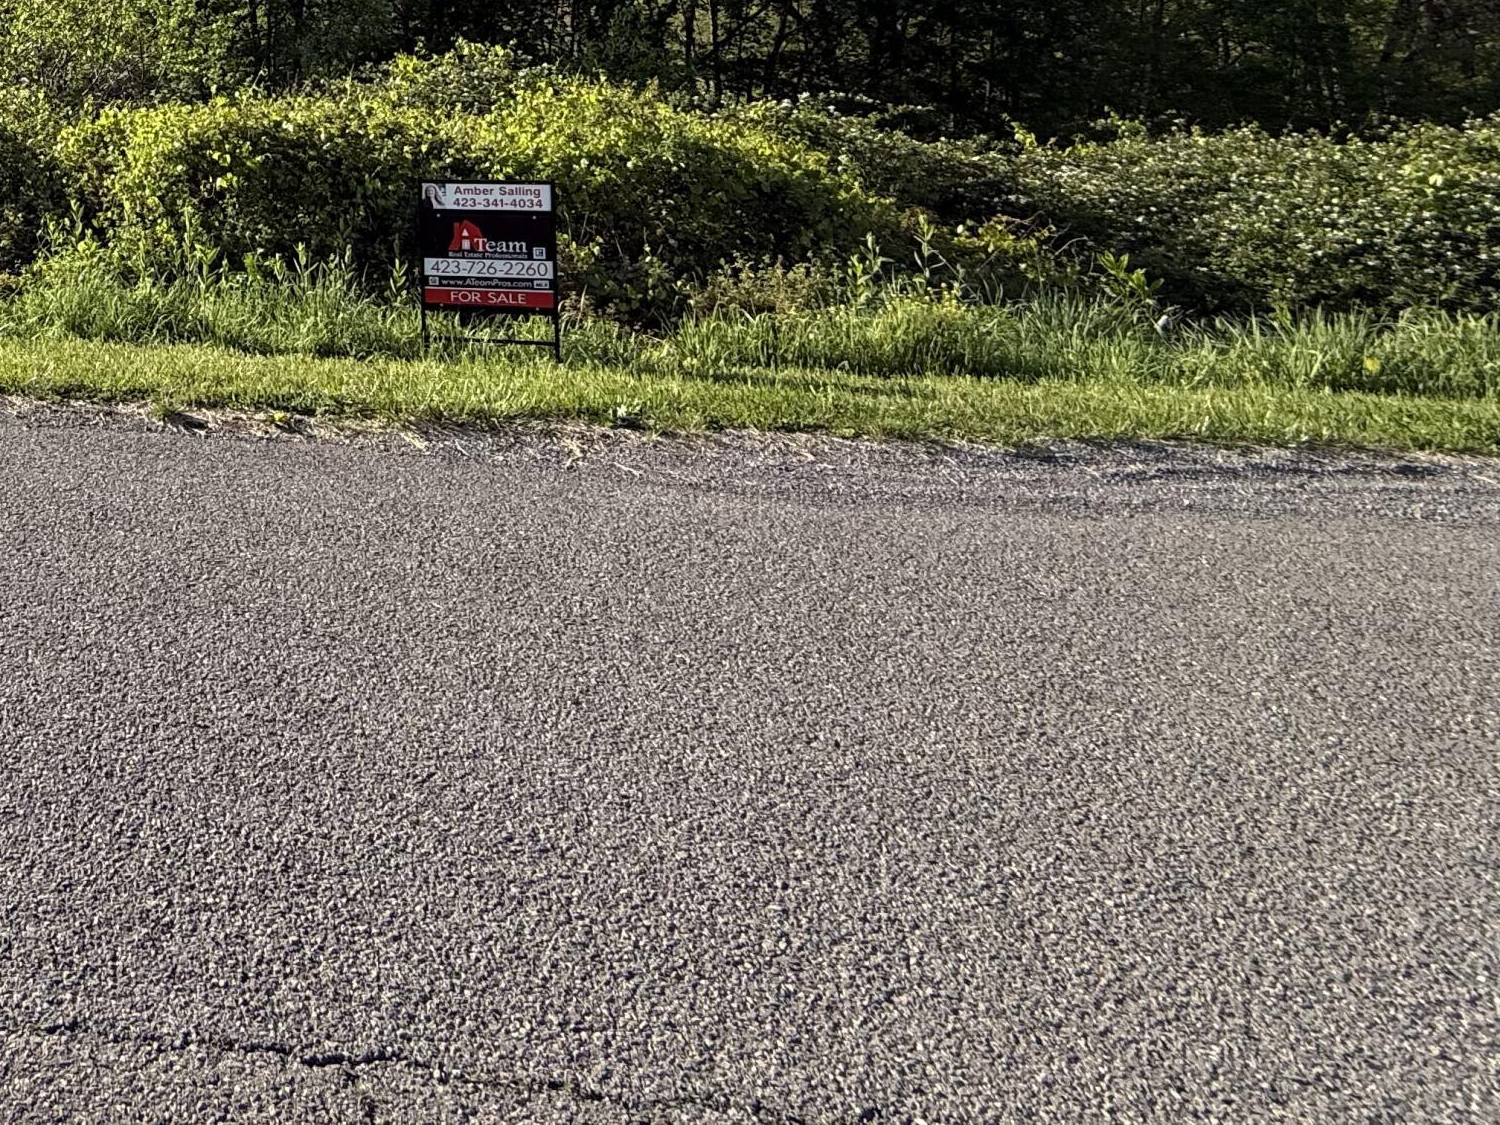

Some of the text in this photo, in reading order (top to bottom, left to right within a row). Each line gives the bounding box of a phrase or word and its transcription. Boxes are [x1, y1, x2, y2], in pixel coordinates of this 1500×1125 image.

[454, 186, 541, 198] Amber Salling
[453, 198, 543, 209] 423-341-4034
[430, 260, 548, 276] 423-726-2260
[441, 278, 532, 288] www.ATeamPros.com
[450, 291, 527, 304] FOR SALE
